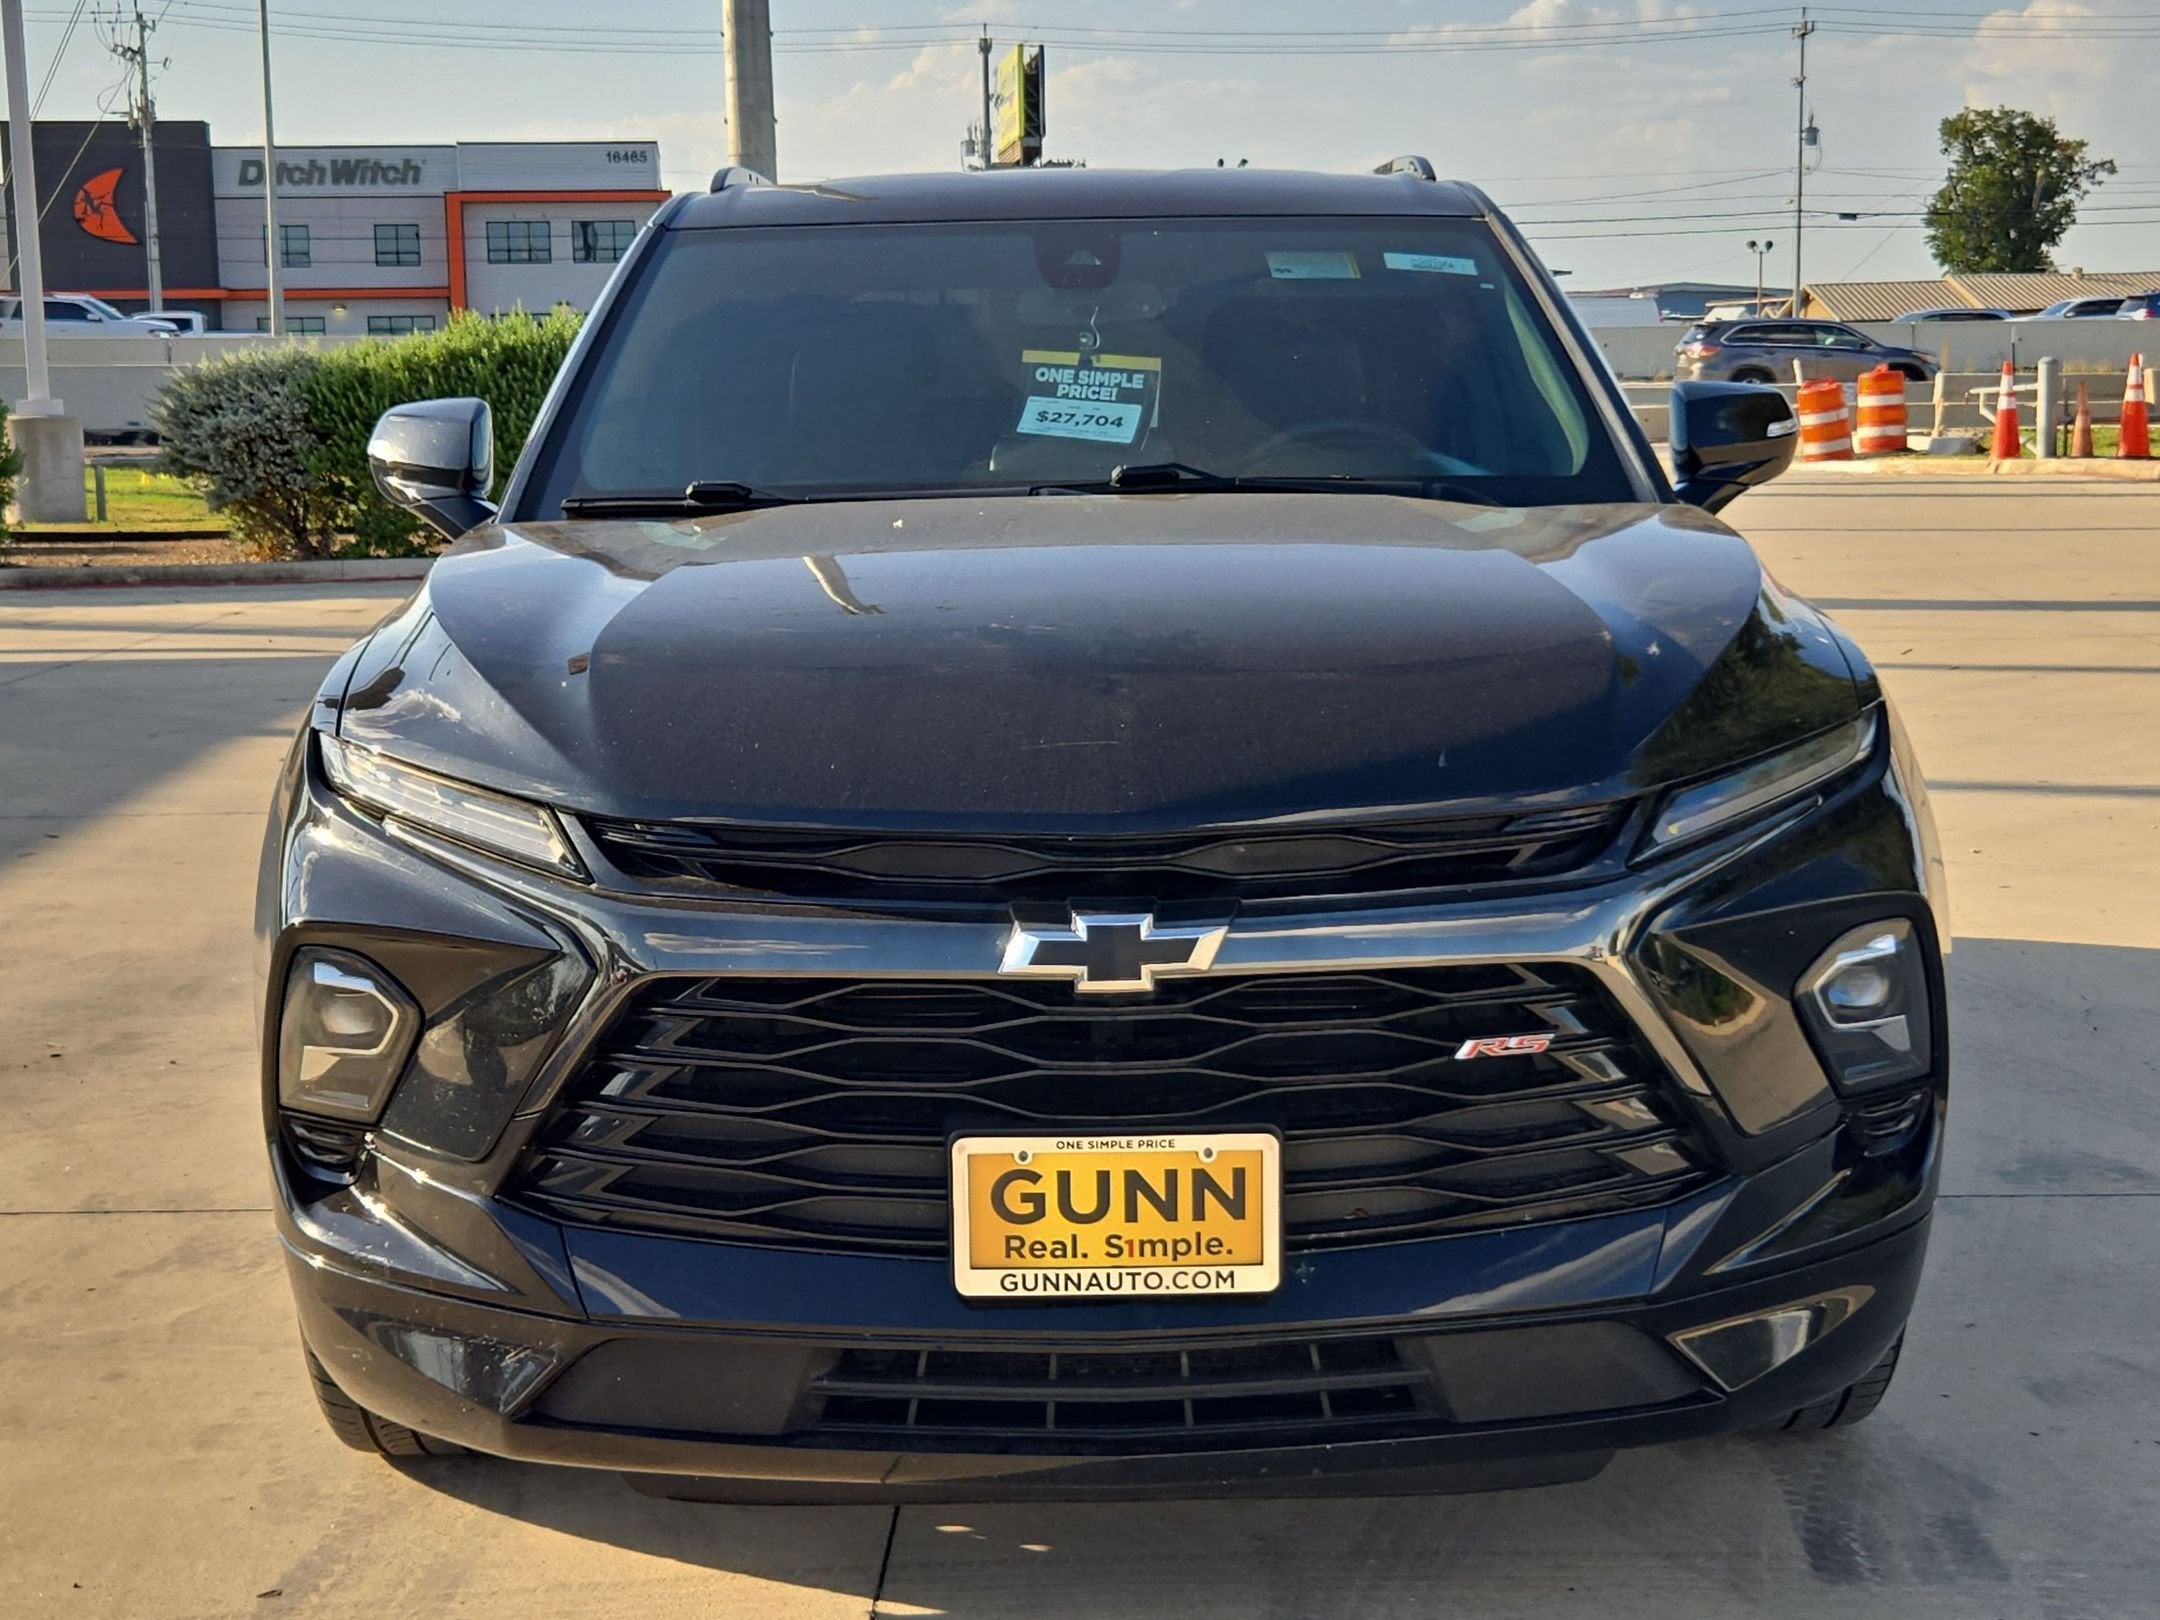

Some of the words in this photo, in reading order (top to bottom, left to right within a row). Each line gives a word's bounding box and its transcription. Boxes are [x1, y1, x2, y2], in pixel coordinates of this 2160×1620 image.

[330, 158, 422, 187] Witch
[1035, 367, 1075, 384] ONE
[1077, 370, 1145, 389] SIMPLE
[1056, 384, 1118, 401] PRICE!
[1035, 410, 1124, 429] $27,704
[1454, 1033, 1555, 1060] RS
[1056, 1140, 1083, 1150] ONE
[1088, 1139, 1133, 1150] SIMPLE
[1138, 1139, 1176, 1149] PRICE
[991, 1167, 1246, 1225] GUNN
[1004, 1233, 1089, 1259] Real.
[1000, 1270, 1236, 1292] GUNNAUTO.COM
